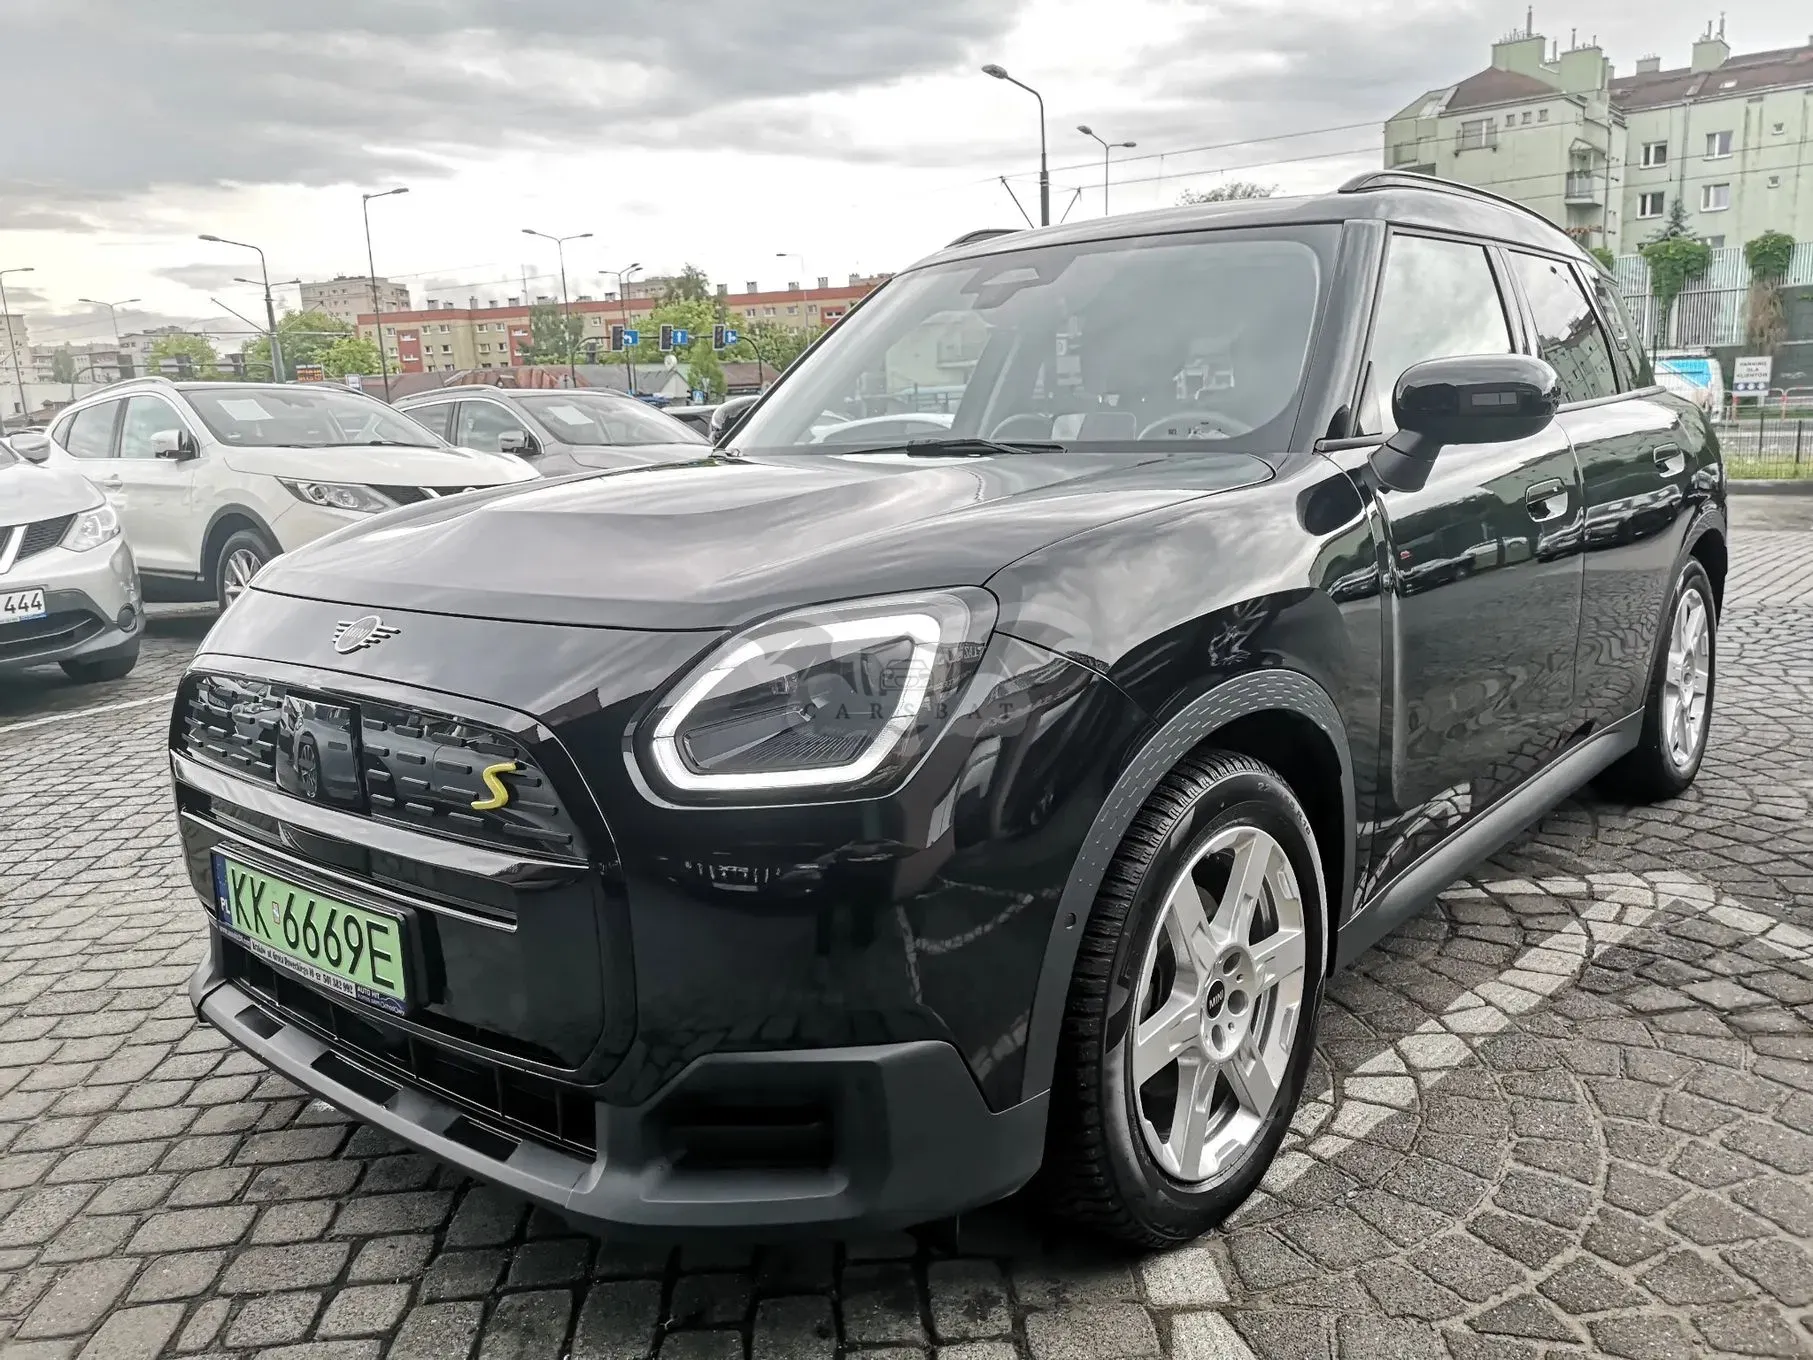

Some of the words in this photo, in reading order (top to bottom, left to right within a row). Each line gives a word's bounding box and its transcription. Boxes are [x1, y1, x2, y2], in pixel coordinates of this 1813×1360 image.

[4, 592, 43, 614] 444
[471, 763, 517, 810] S
[220, 896, 231, 915] PL
[231, 868, 272, 940] KK
[283, 892, 395, 990] 6669E
[357, 986, 370, 997] AUTO
[1208, 989, 1224, 1010] MINI
